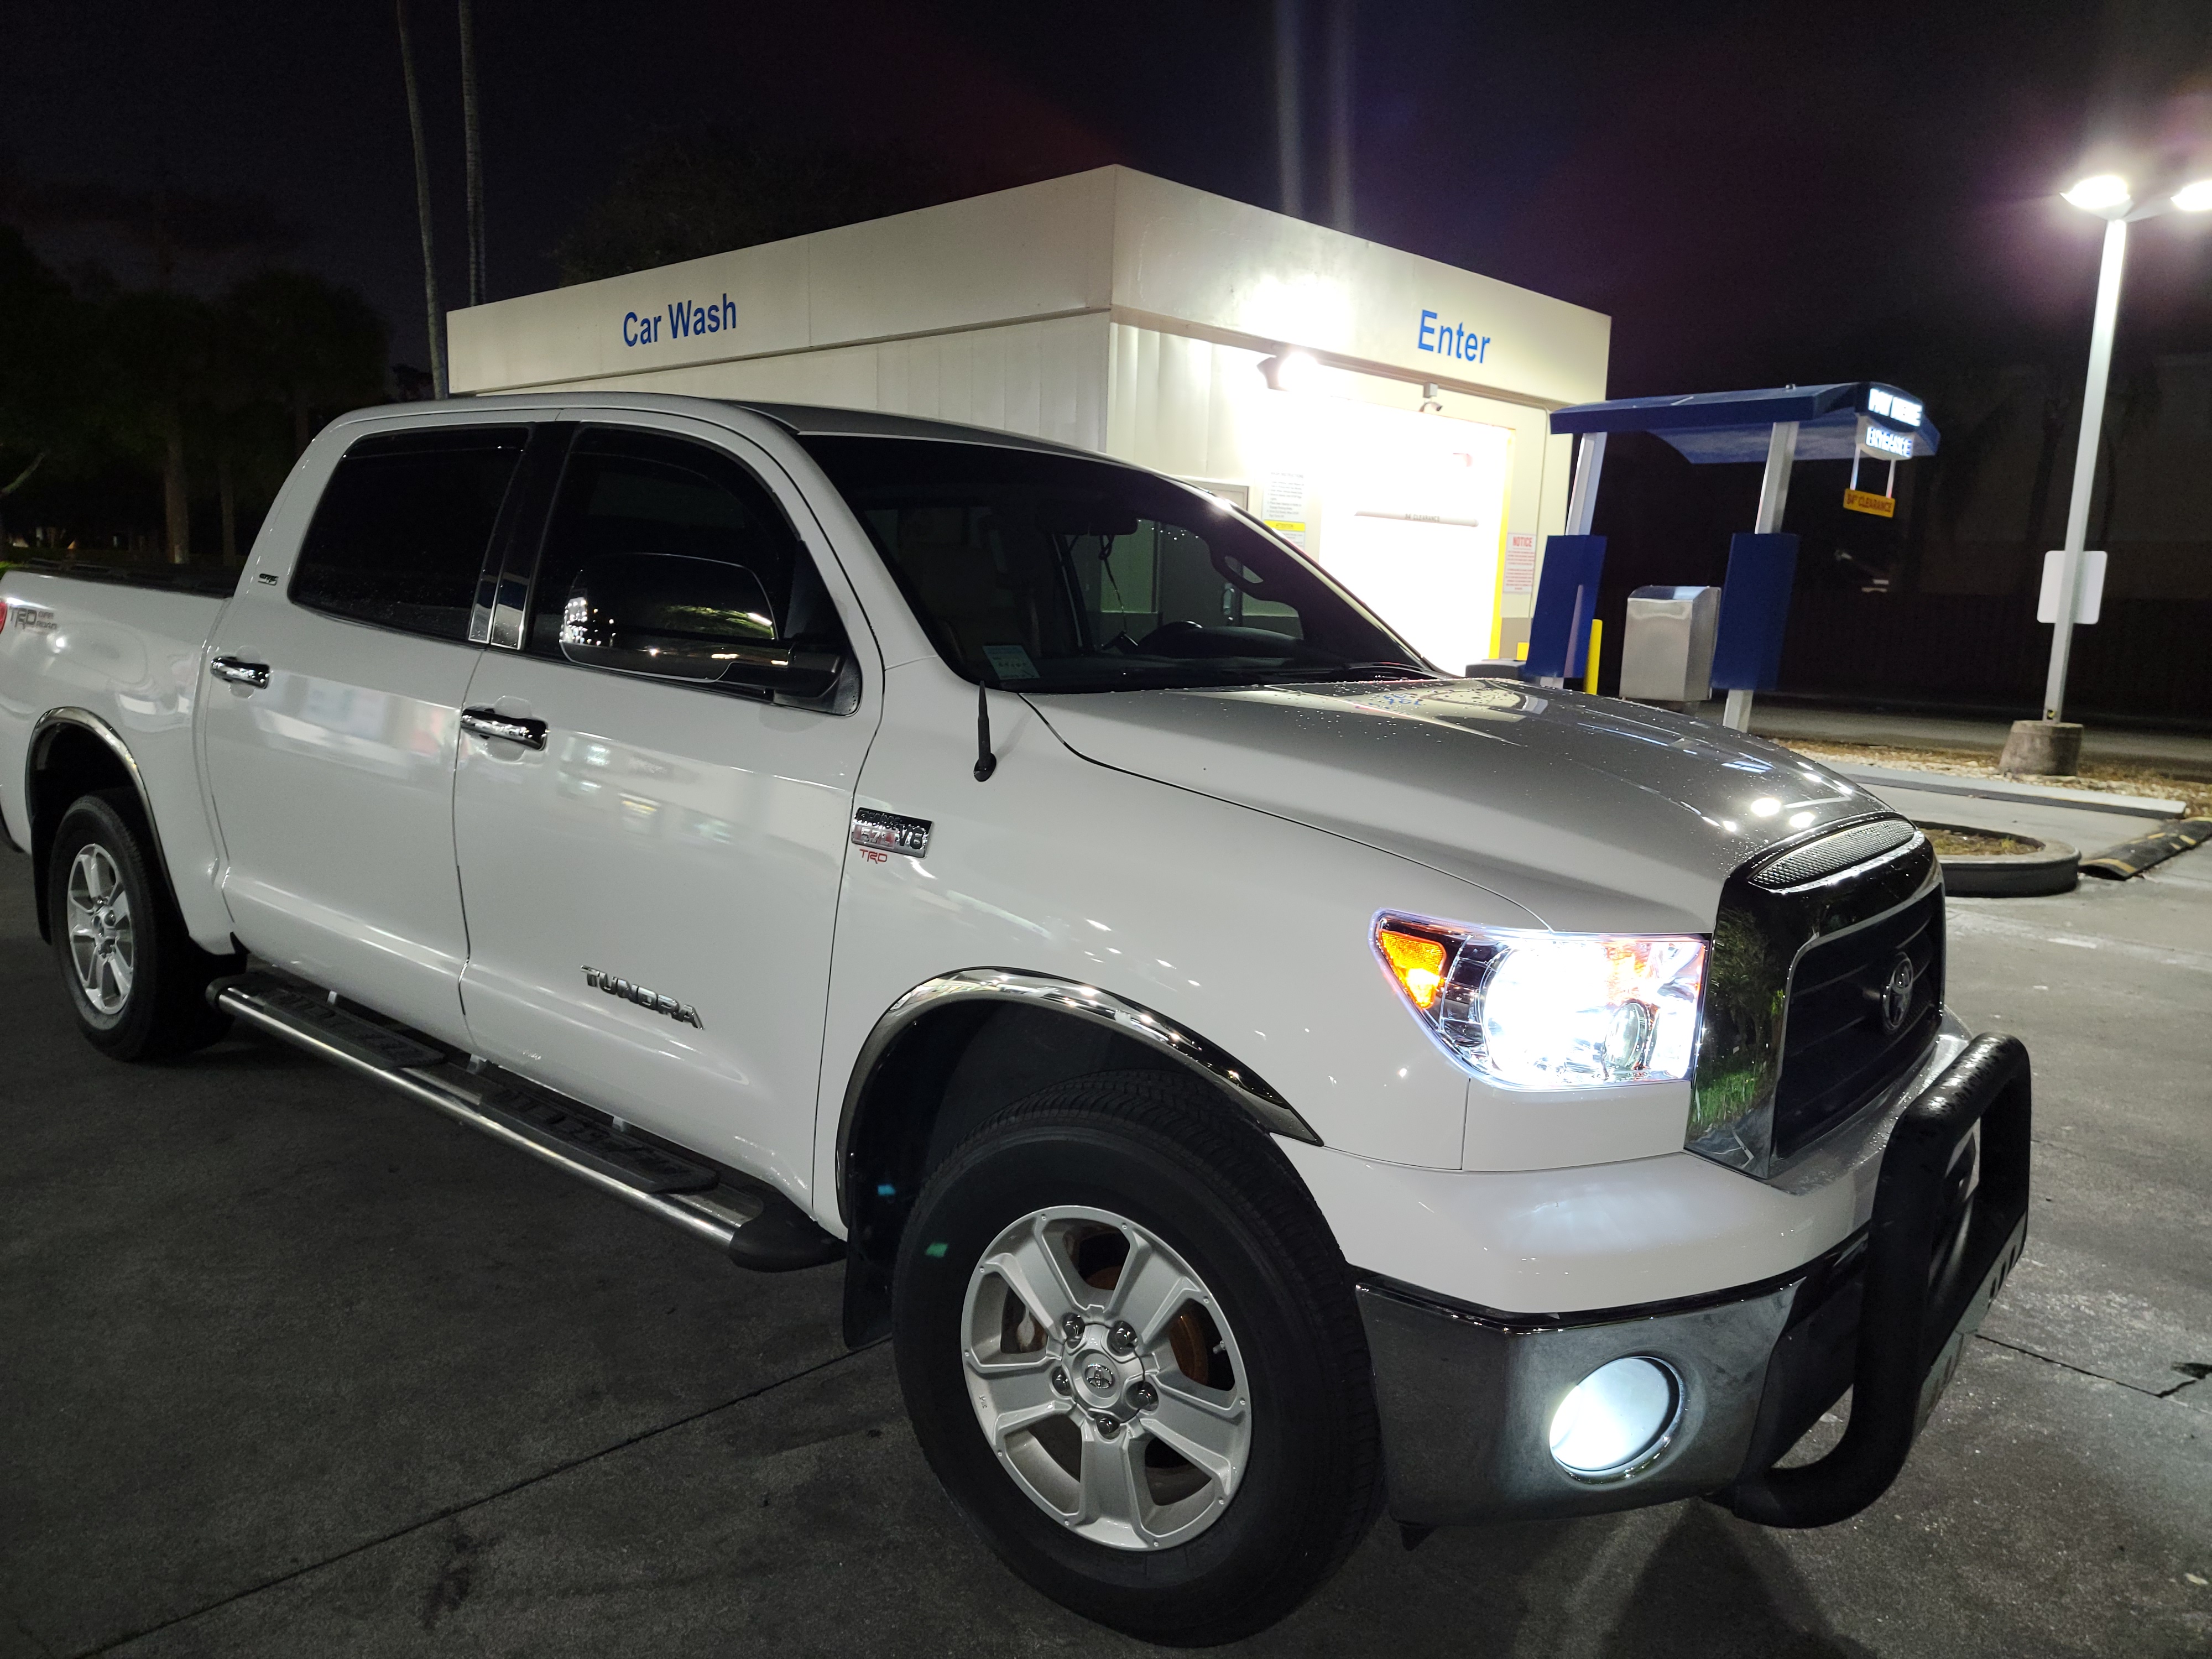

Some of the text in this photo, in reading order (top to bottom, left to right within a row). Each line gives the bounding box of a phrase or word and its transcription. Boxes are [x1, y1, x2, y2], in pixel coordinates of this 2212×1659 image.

[623, 293, 737, 347] Car Wash
[1418, 309, 1491, 364] Enter
[1512, 536, 1532, 547] NOTICE
[9, 606, 37, 629] TRD
[897, 823, 926, 850] V8
[859, 848, 888, 864] TRD
[580, 965, 705, 1030] TUNDRA
